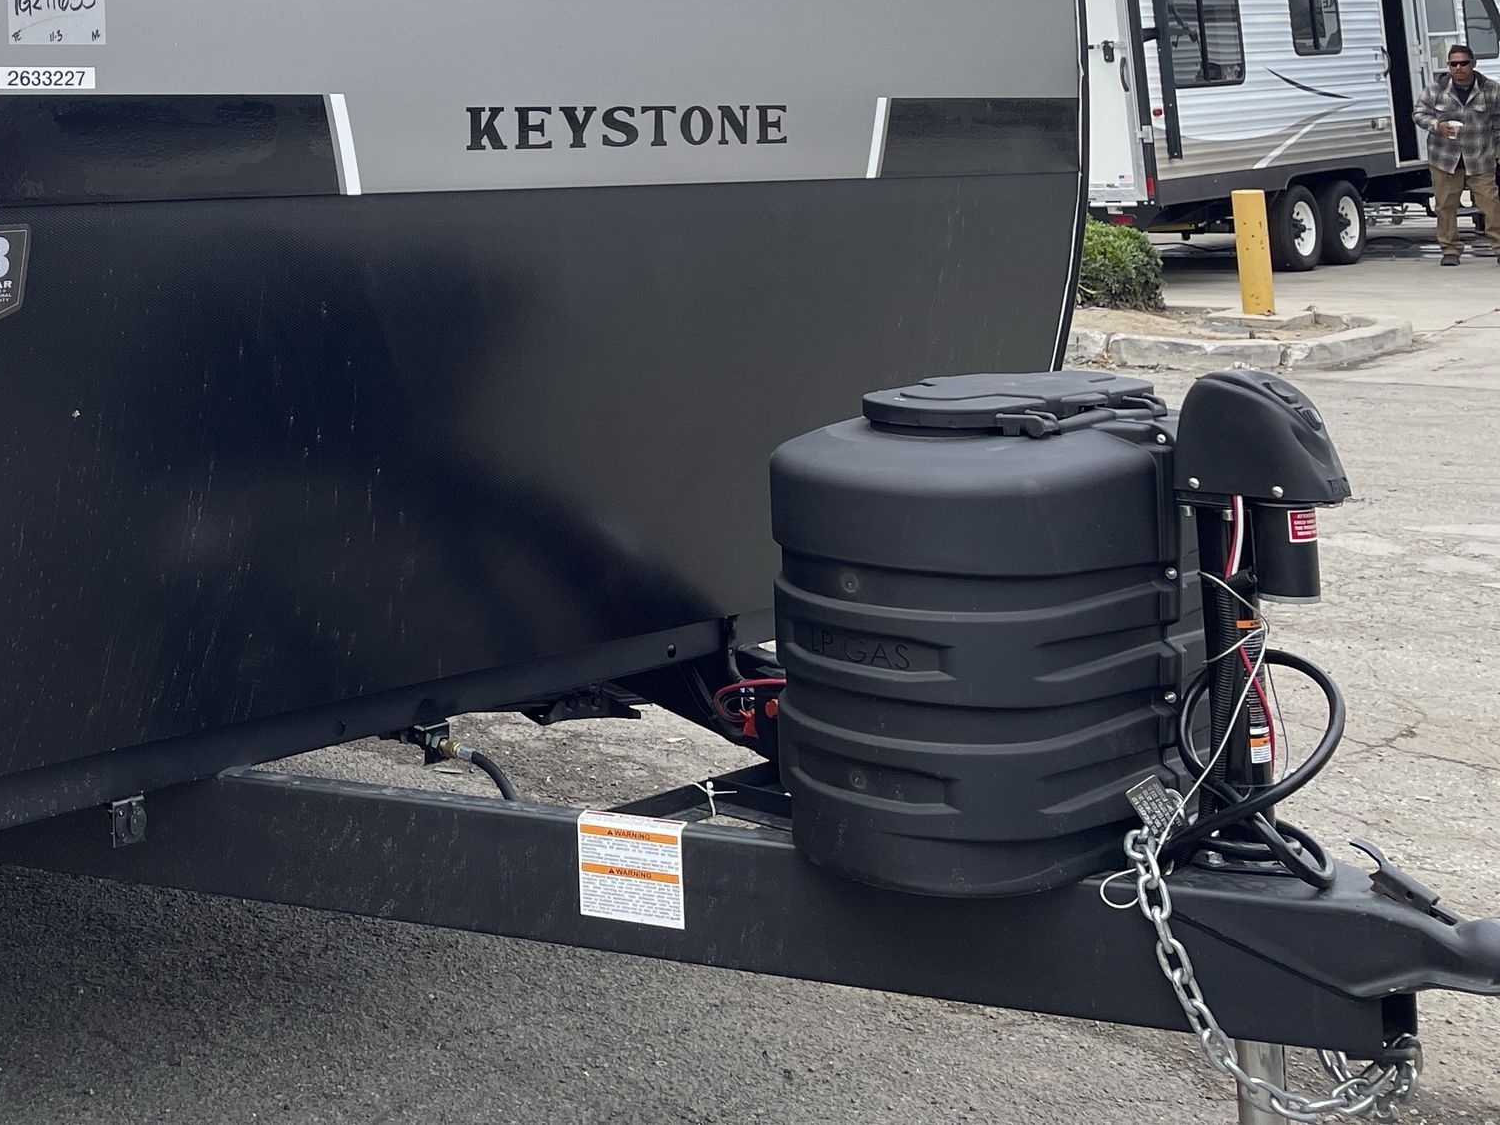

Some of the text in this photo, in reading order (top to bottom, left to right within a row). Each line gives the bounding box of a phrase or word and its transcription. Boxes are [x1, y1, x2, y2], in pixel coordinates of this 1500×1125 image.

[7, 70, 86, 86] 2633227
[466, 105, 787, 150] KEYSTONE
[811, 627, 910, 670] LP GAS
[615, 829, 651, 841] WARNING
[616, 868, 652, 880] WARNING
